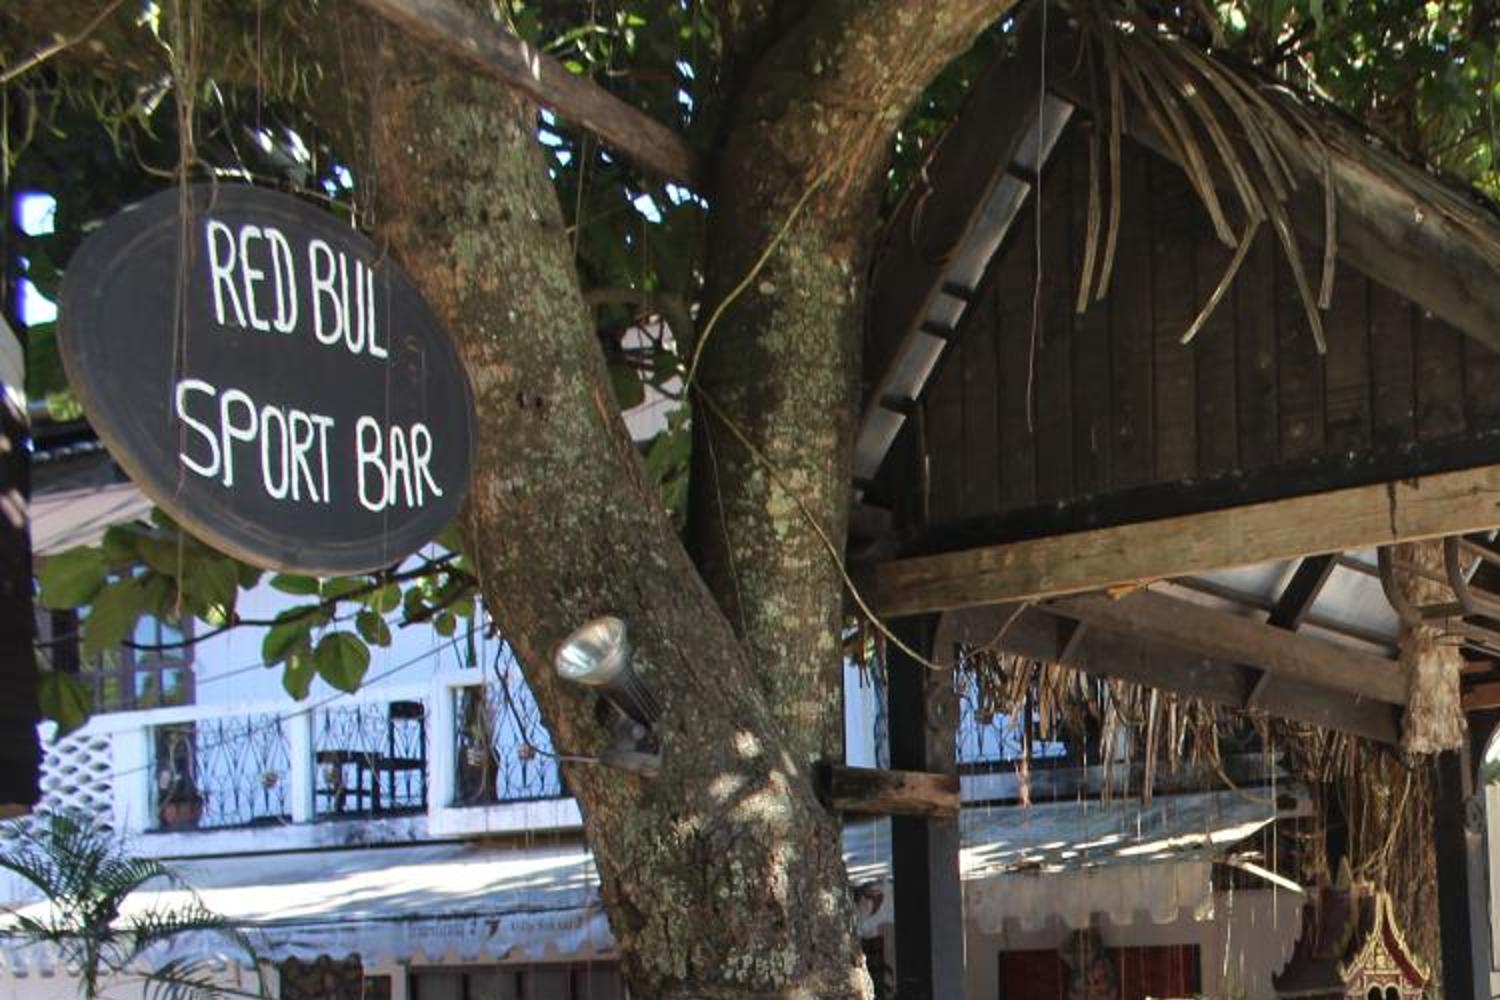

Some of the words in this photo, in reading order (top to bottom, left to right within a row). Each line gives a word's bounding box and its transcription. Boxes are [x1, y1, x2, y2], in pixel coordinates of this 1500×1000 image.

[206, 220, 300, 335] RED
[308, 239, 389, 360] BUL
[174, 380, 334, 505] SPORT
[355, 415, 443, 513] BAR
